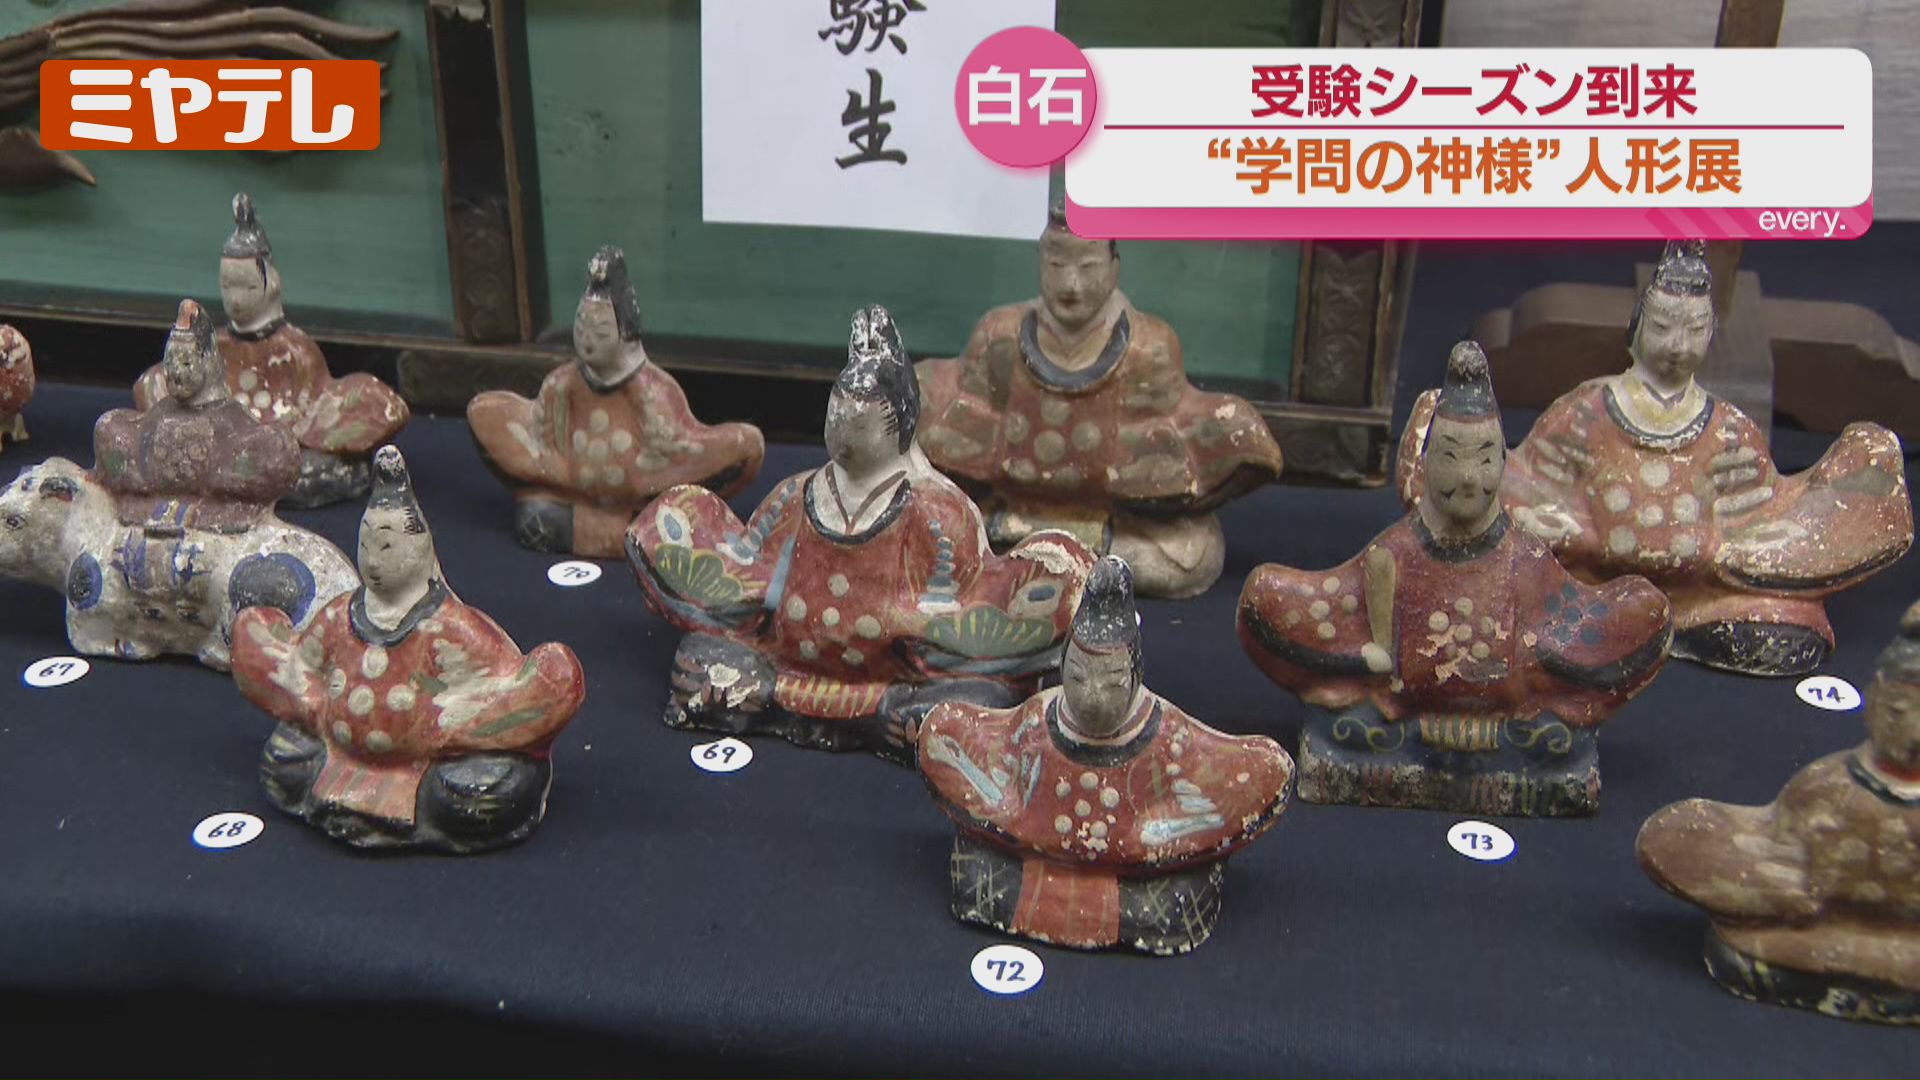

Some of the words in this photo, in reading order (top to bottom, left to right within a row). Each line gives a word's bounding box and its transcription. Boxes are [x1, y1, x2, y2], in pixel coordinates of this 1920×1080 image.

[563, 565, 592, 580] 70
[38, 662, 75, 677] 67
[1807, 686, 1845, 704] 74
[702, 743, 737, 764] 69
[207, 820, 247, 839] 68
[1461, 832, 1494, 851] 73
[986, 959, 1026, 982] 72
